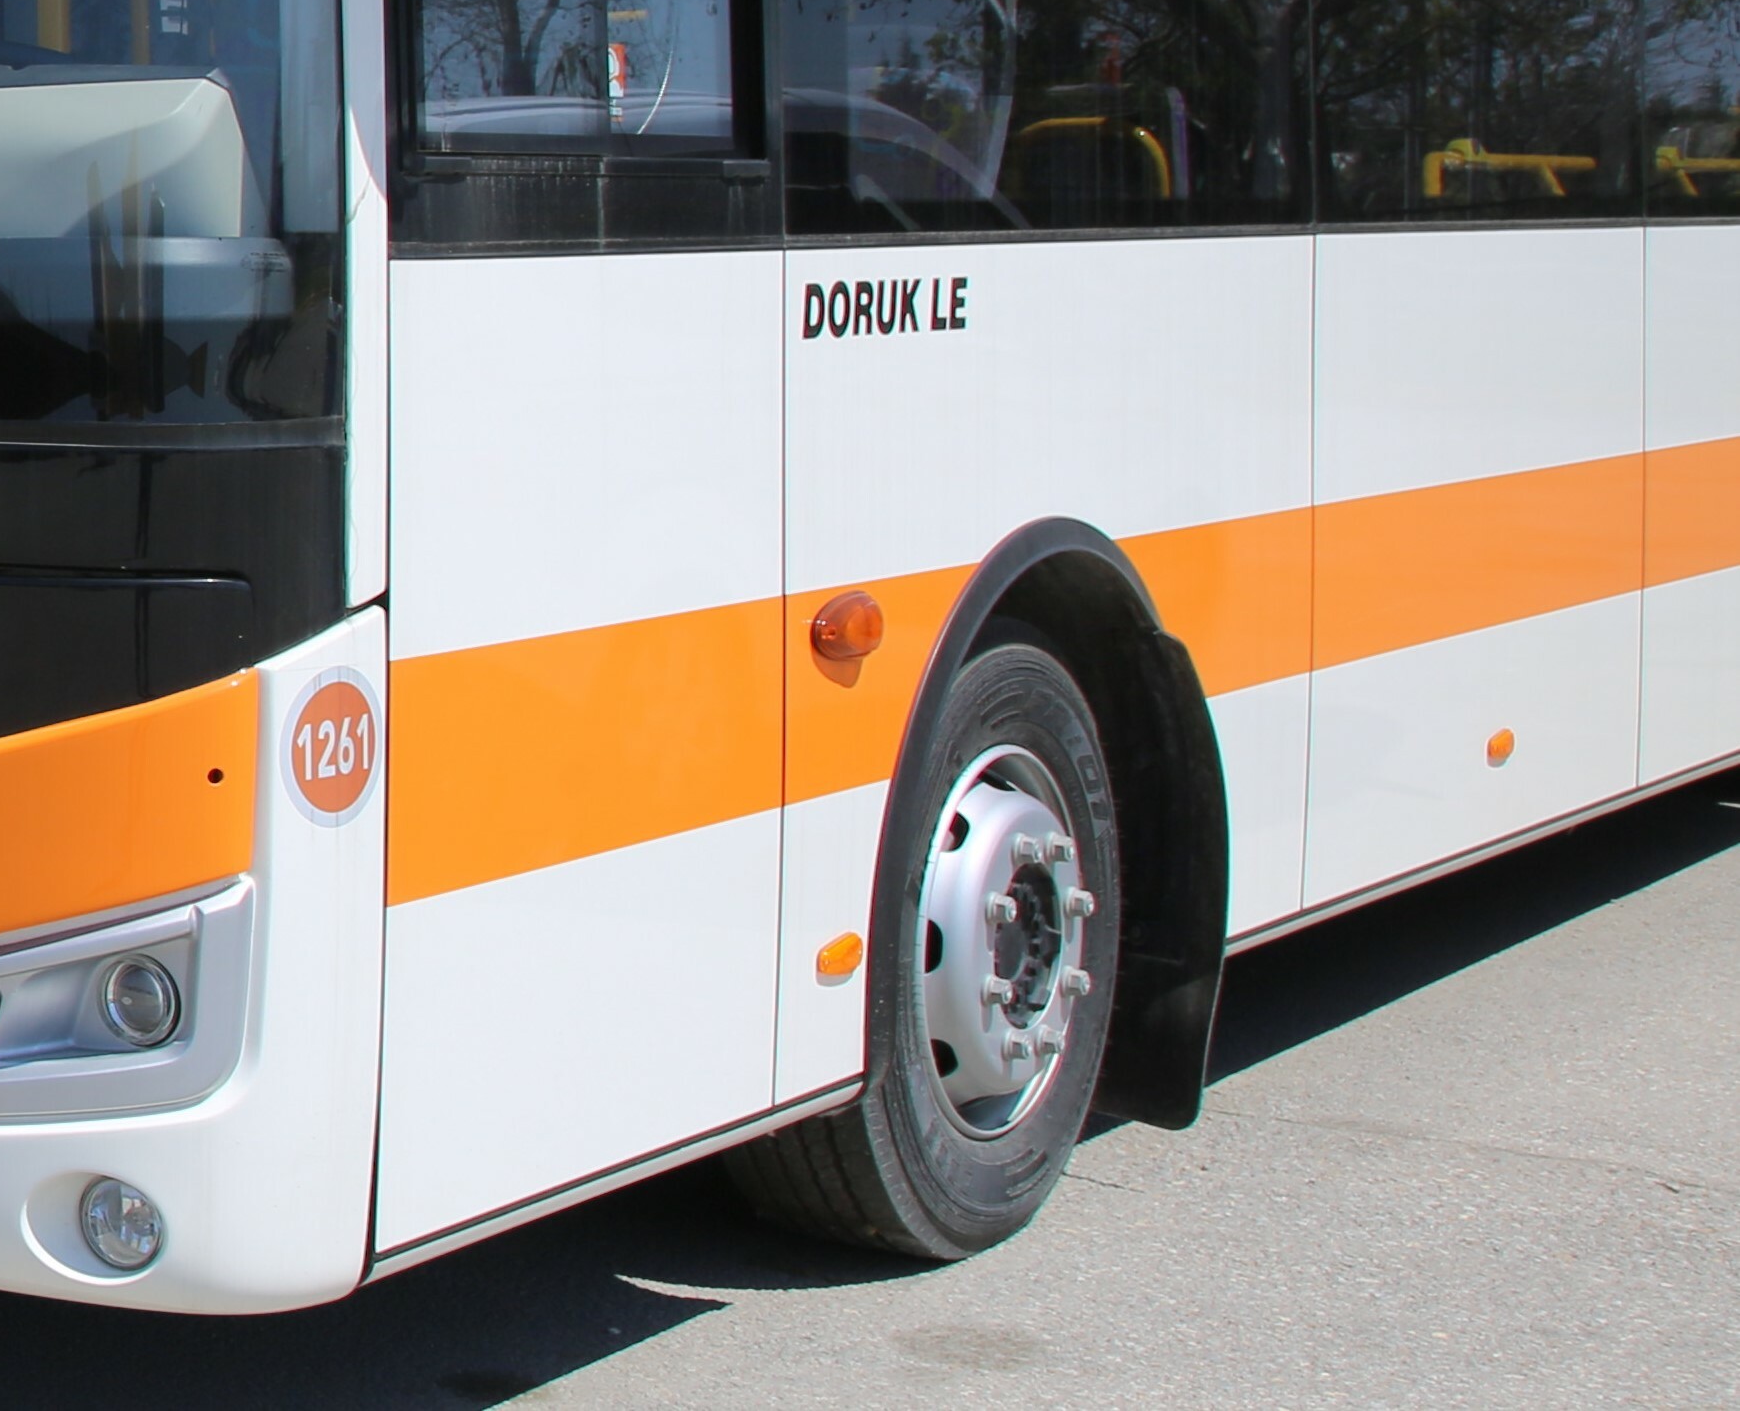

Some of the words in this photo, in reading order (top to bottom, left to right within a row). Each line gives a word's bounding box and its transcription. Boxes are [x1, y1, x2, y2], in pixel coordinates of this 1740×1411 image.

[803, 278, 921, 339] DORUK
[931, 277, 968, 331] LE
[296, 714, 369, 781] 1261
